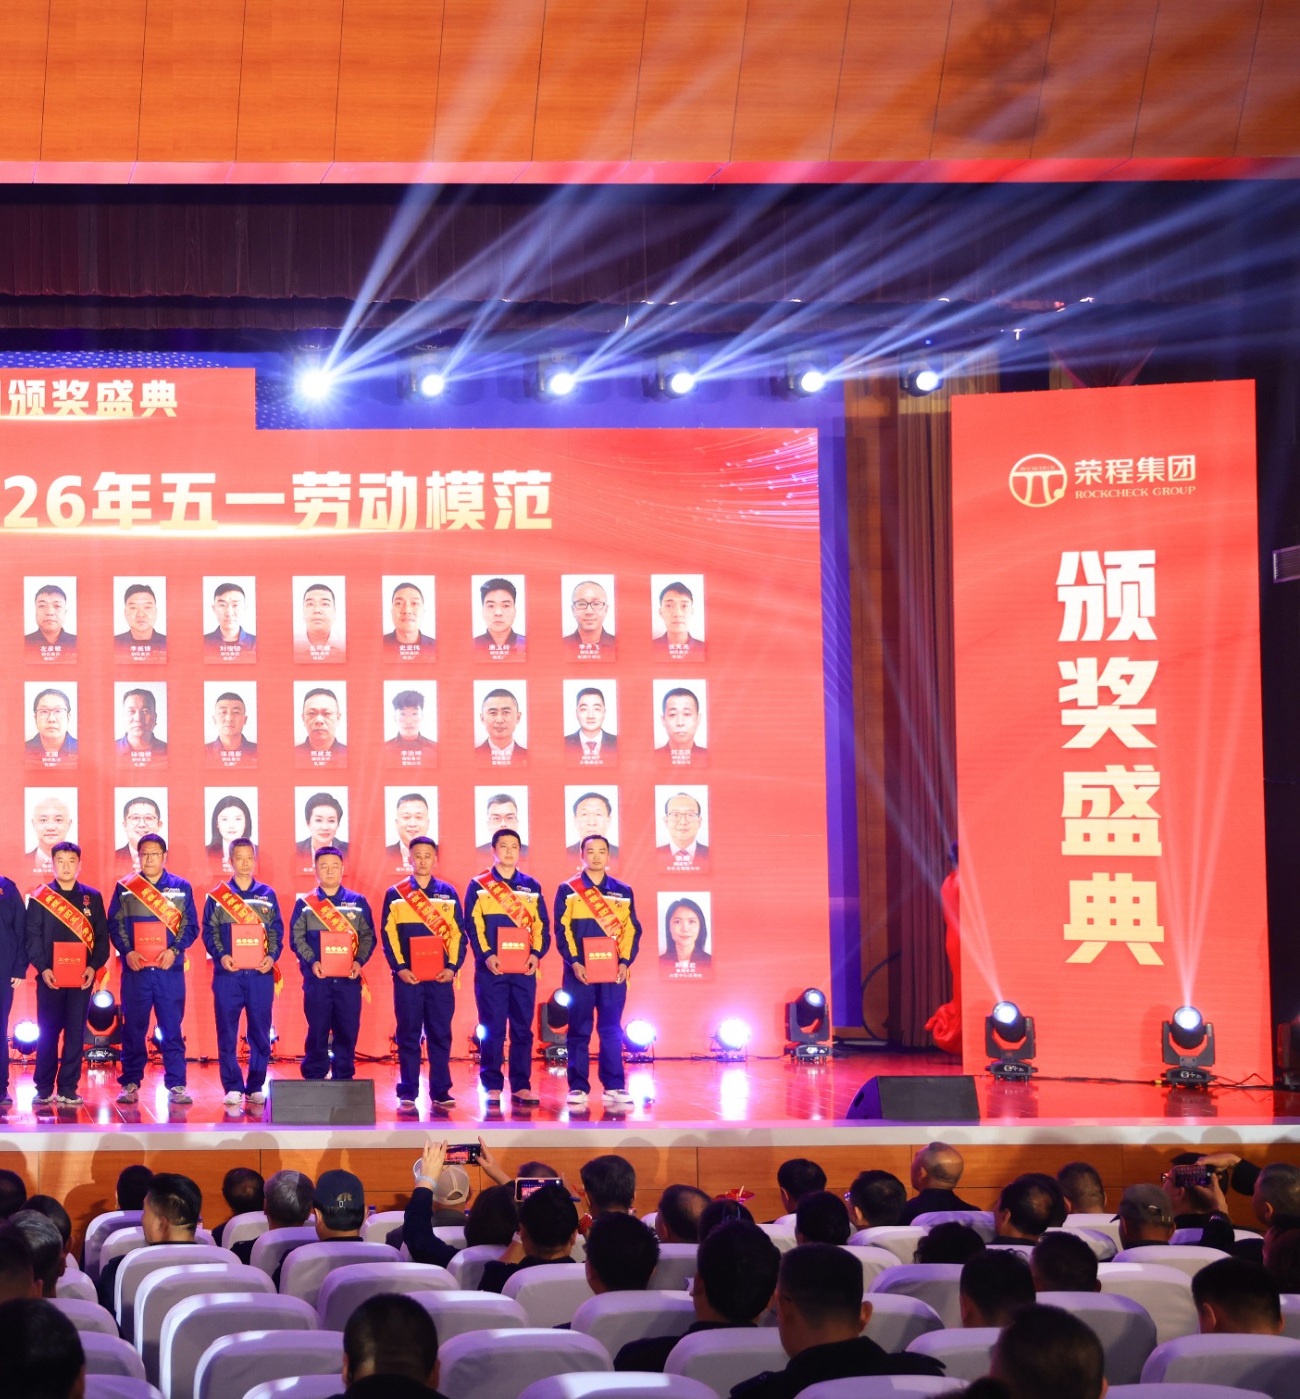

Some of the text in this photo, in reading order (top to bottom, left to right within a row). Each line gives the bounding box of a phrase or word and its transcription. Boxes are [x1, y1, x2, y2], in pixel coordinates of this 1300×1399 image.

[1074, 455, 1196, 485] 荣程集团
[1075, 485, 1196, 499] ROCKCHECK GROUP
[1056, 549, 1164, 966] 颁奖盛典
